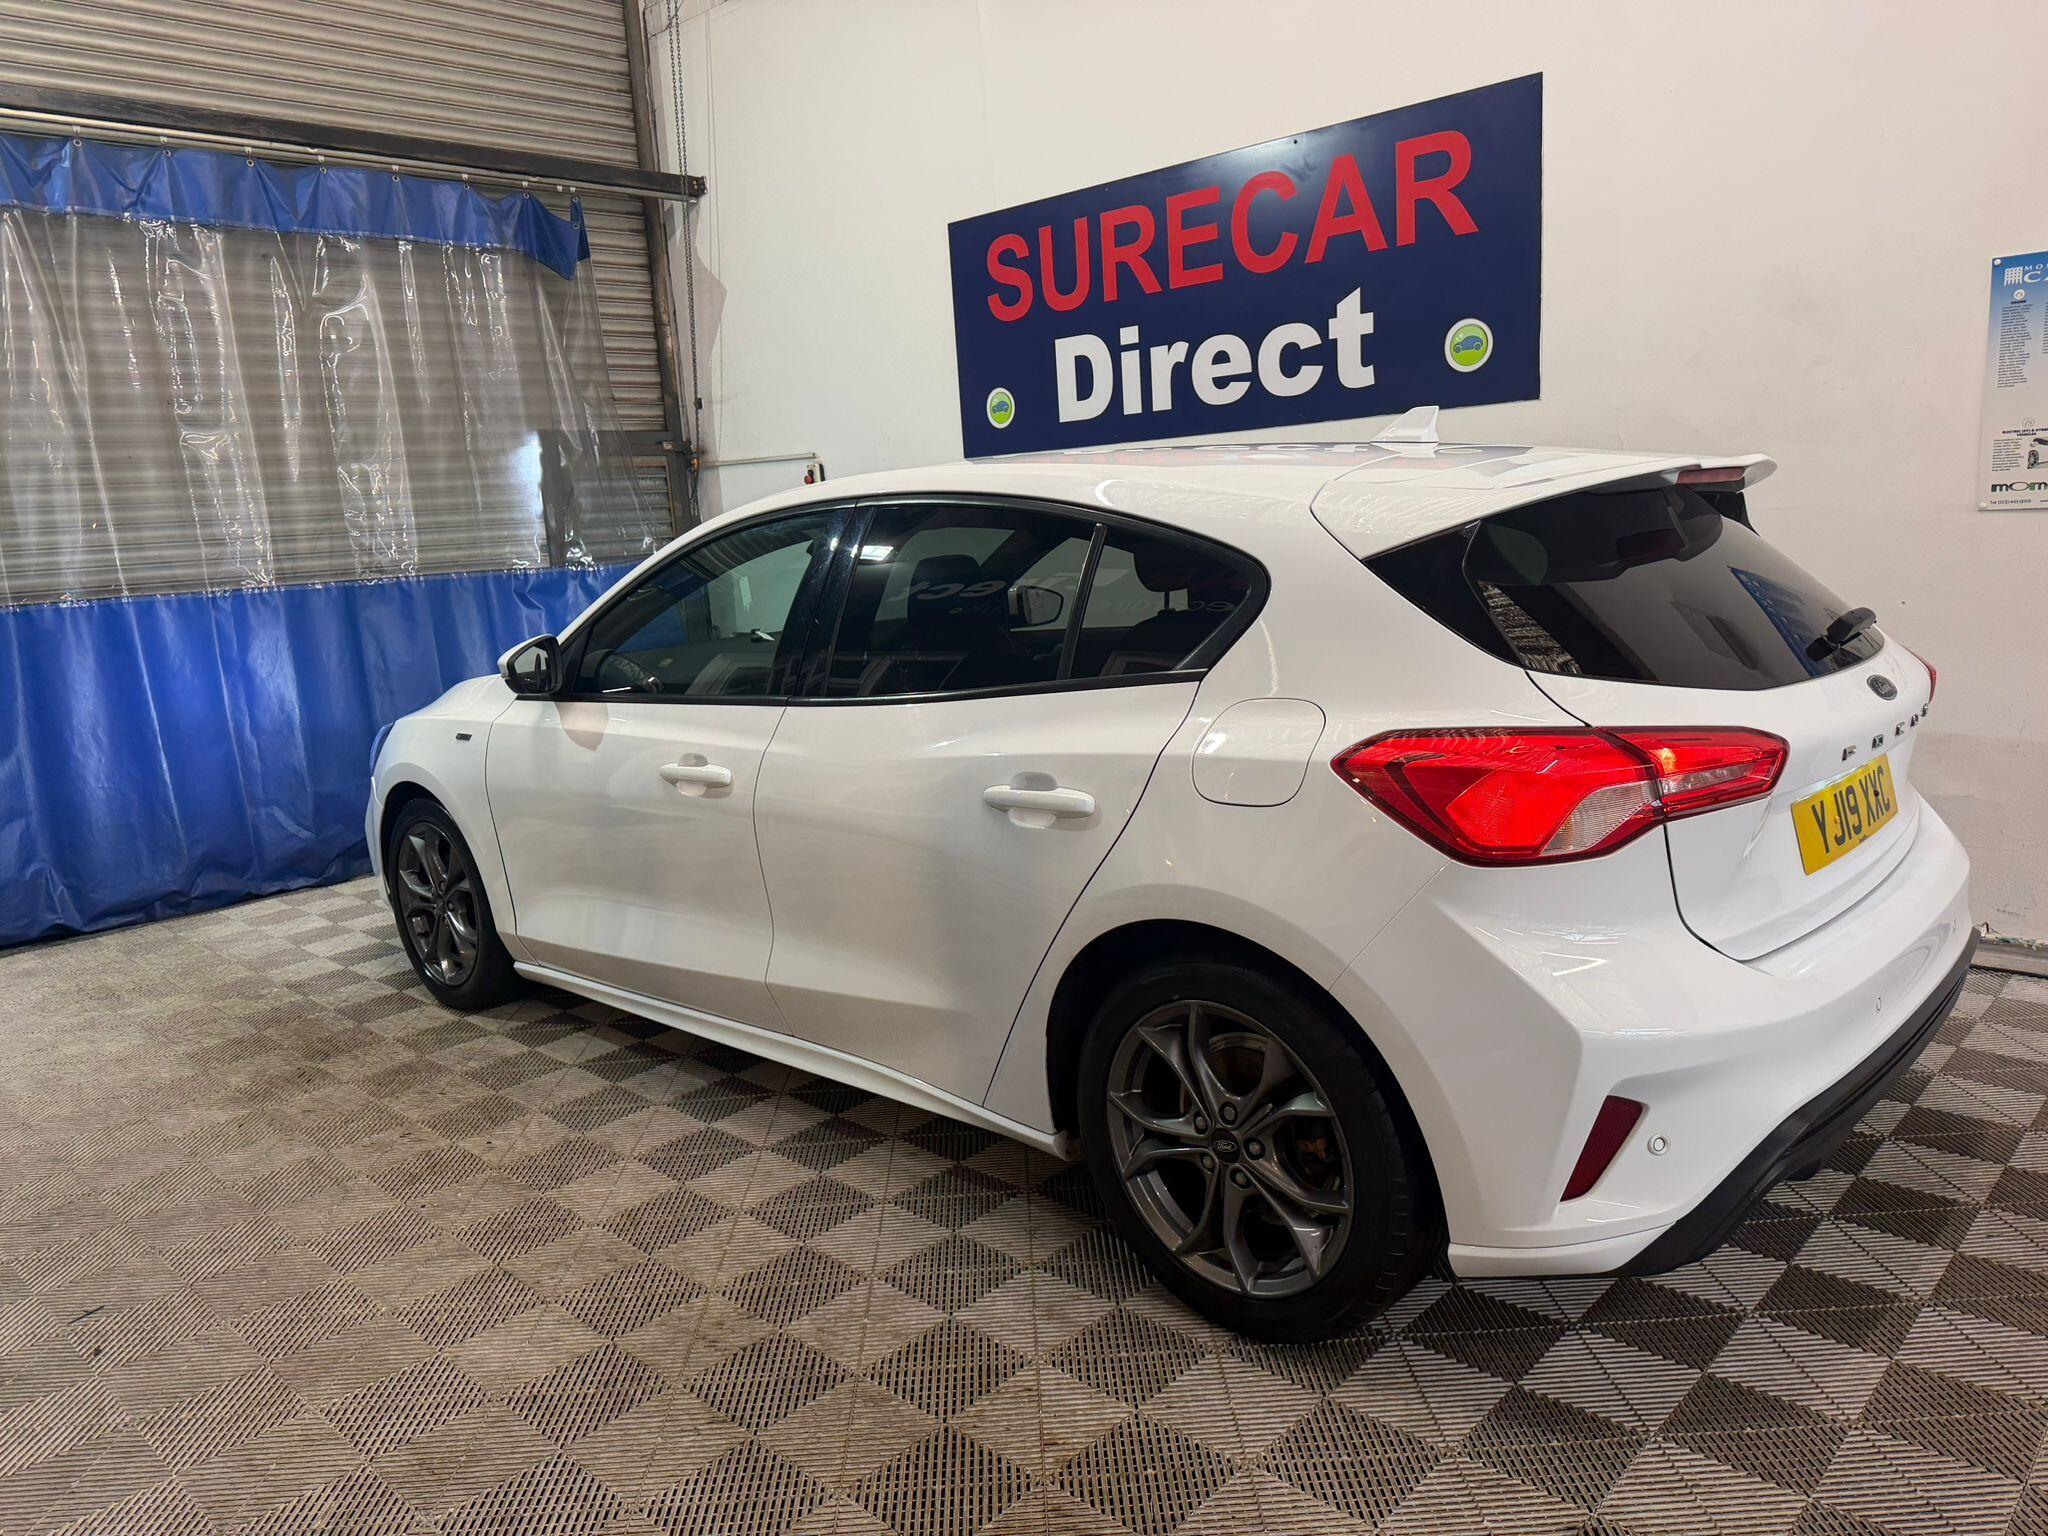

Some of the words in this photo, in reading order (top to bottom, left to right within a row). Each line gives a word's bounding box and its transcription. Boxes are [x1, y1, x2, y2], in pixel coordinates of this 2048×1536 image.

[987, 130, 1479, 322] SURECAR
[2023, 270, 2048, 283] C
[1054, 286, 1376, 423] Direct
[1842, 703, 1929, 761] FOCUS
[1811, 785, 1862, 854] YJ19
[1859, 765, 1890, 826] XXC
